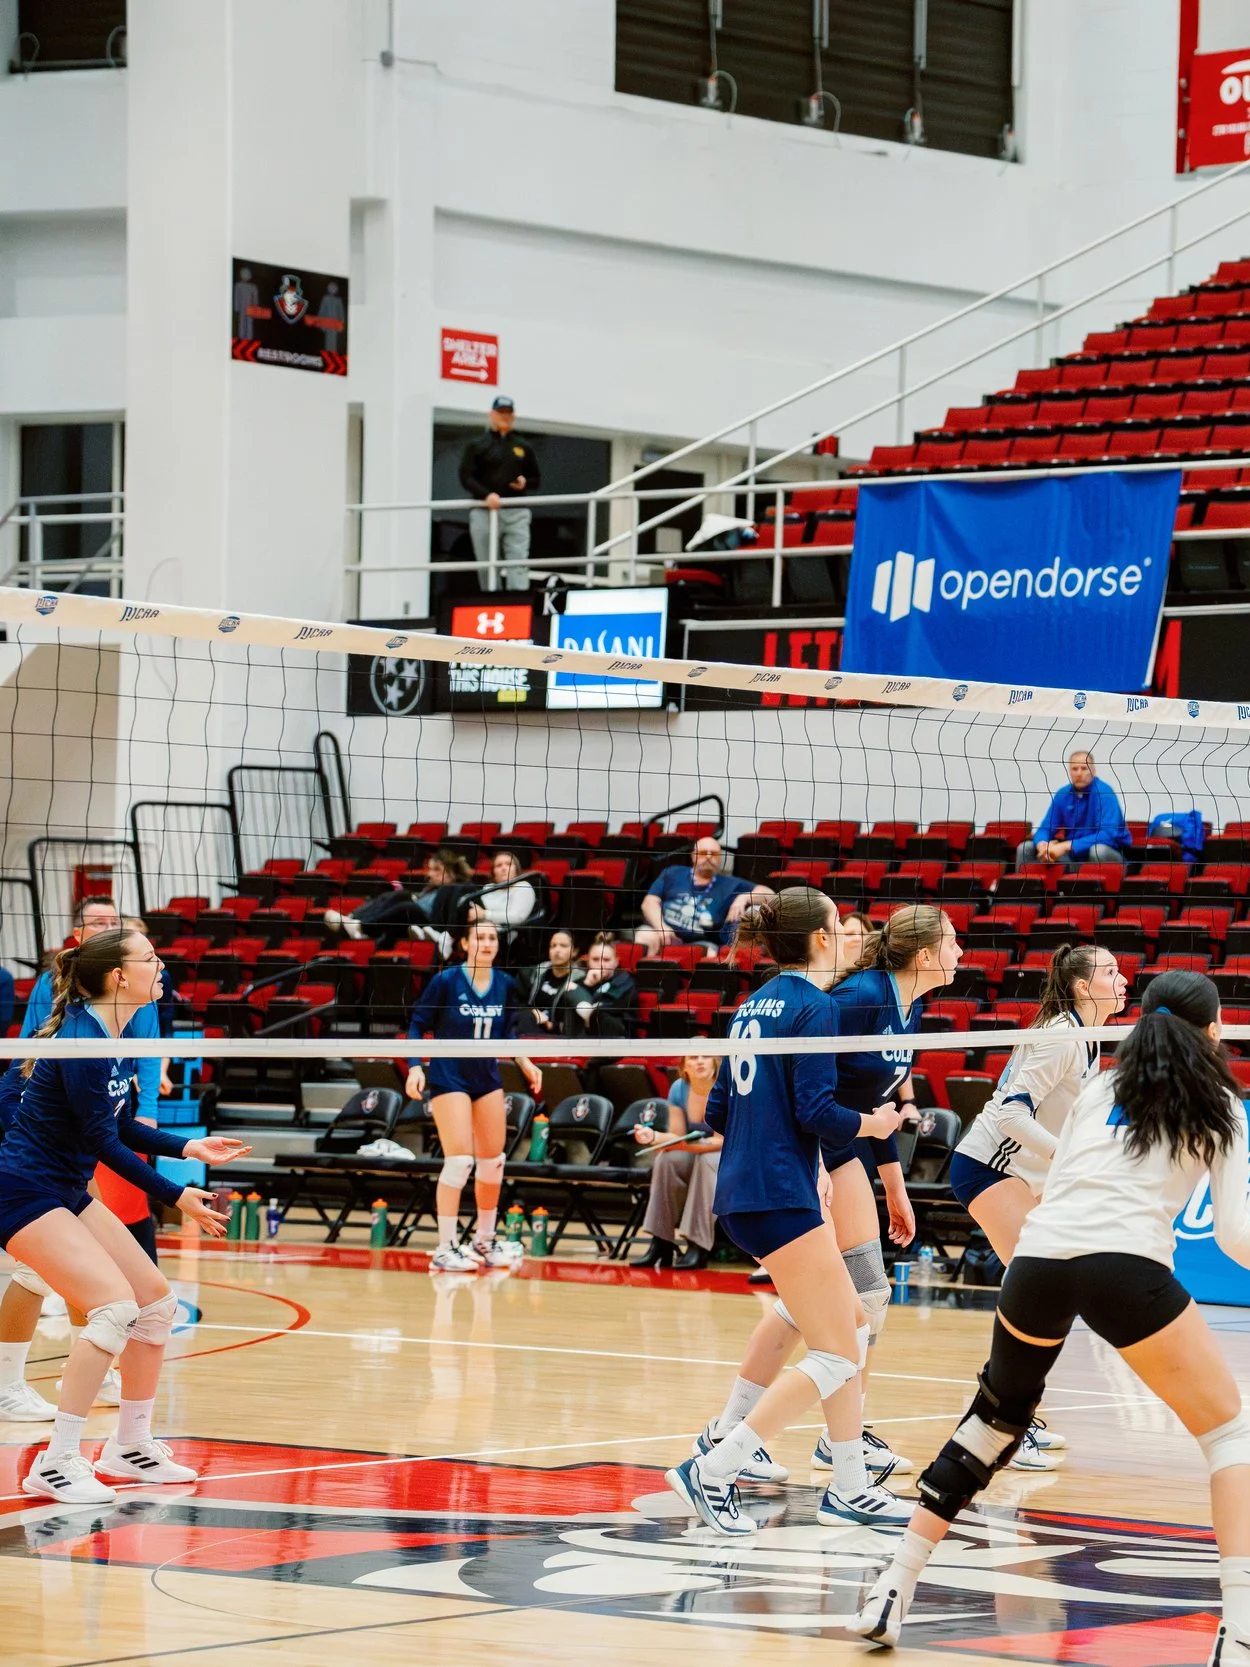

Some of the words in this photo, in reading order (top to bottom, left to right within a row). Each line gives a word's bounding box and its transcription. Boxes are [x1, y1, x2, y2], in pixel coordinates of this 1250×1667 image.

[442, 336, 498, 357] SHELTER
[451, 350, 489, 368] AREA
[939, 556, 1143, 610] opendorse
[119, 606, 160, 622] NJCAA
[294, 626, 333, 640] NJCAA
[1008, 690, 1033, 705] NJCAA
[1126, 698, 1149, 713] NJCAA
[459, 1003, 503, 1017] COLBY
[472, 1017, 493, 1039] 11
[881, 1066, 908, 1097] 7
